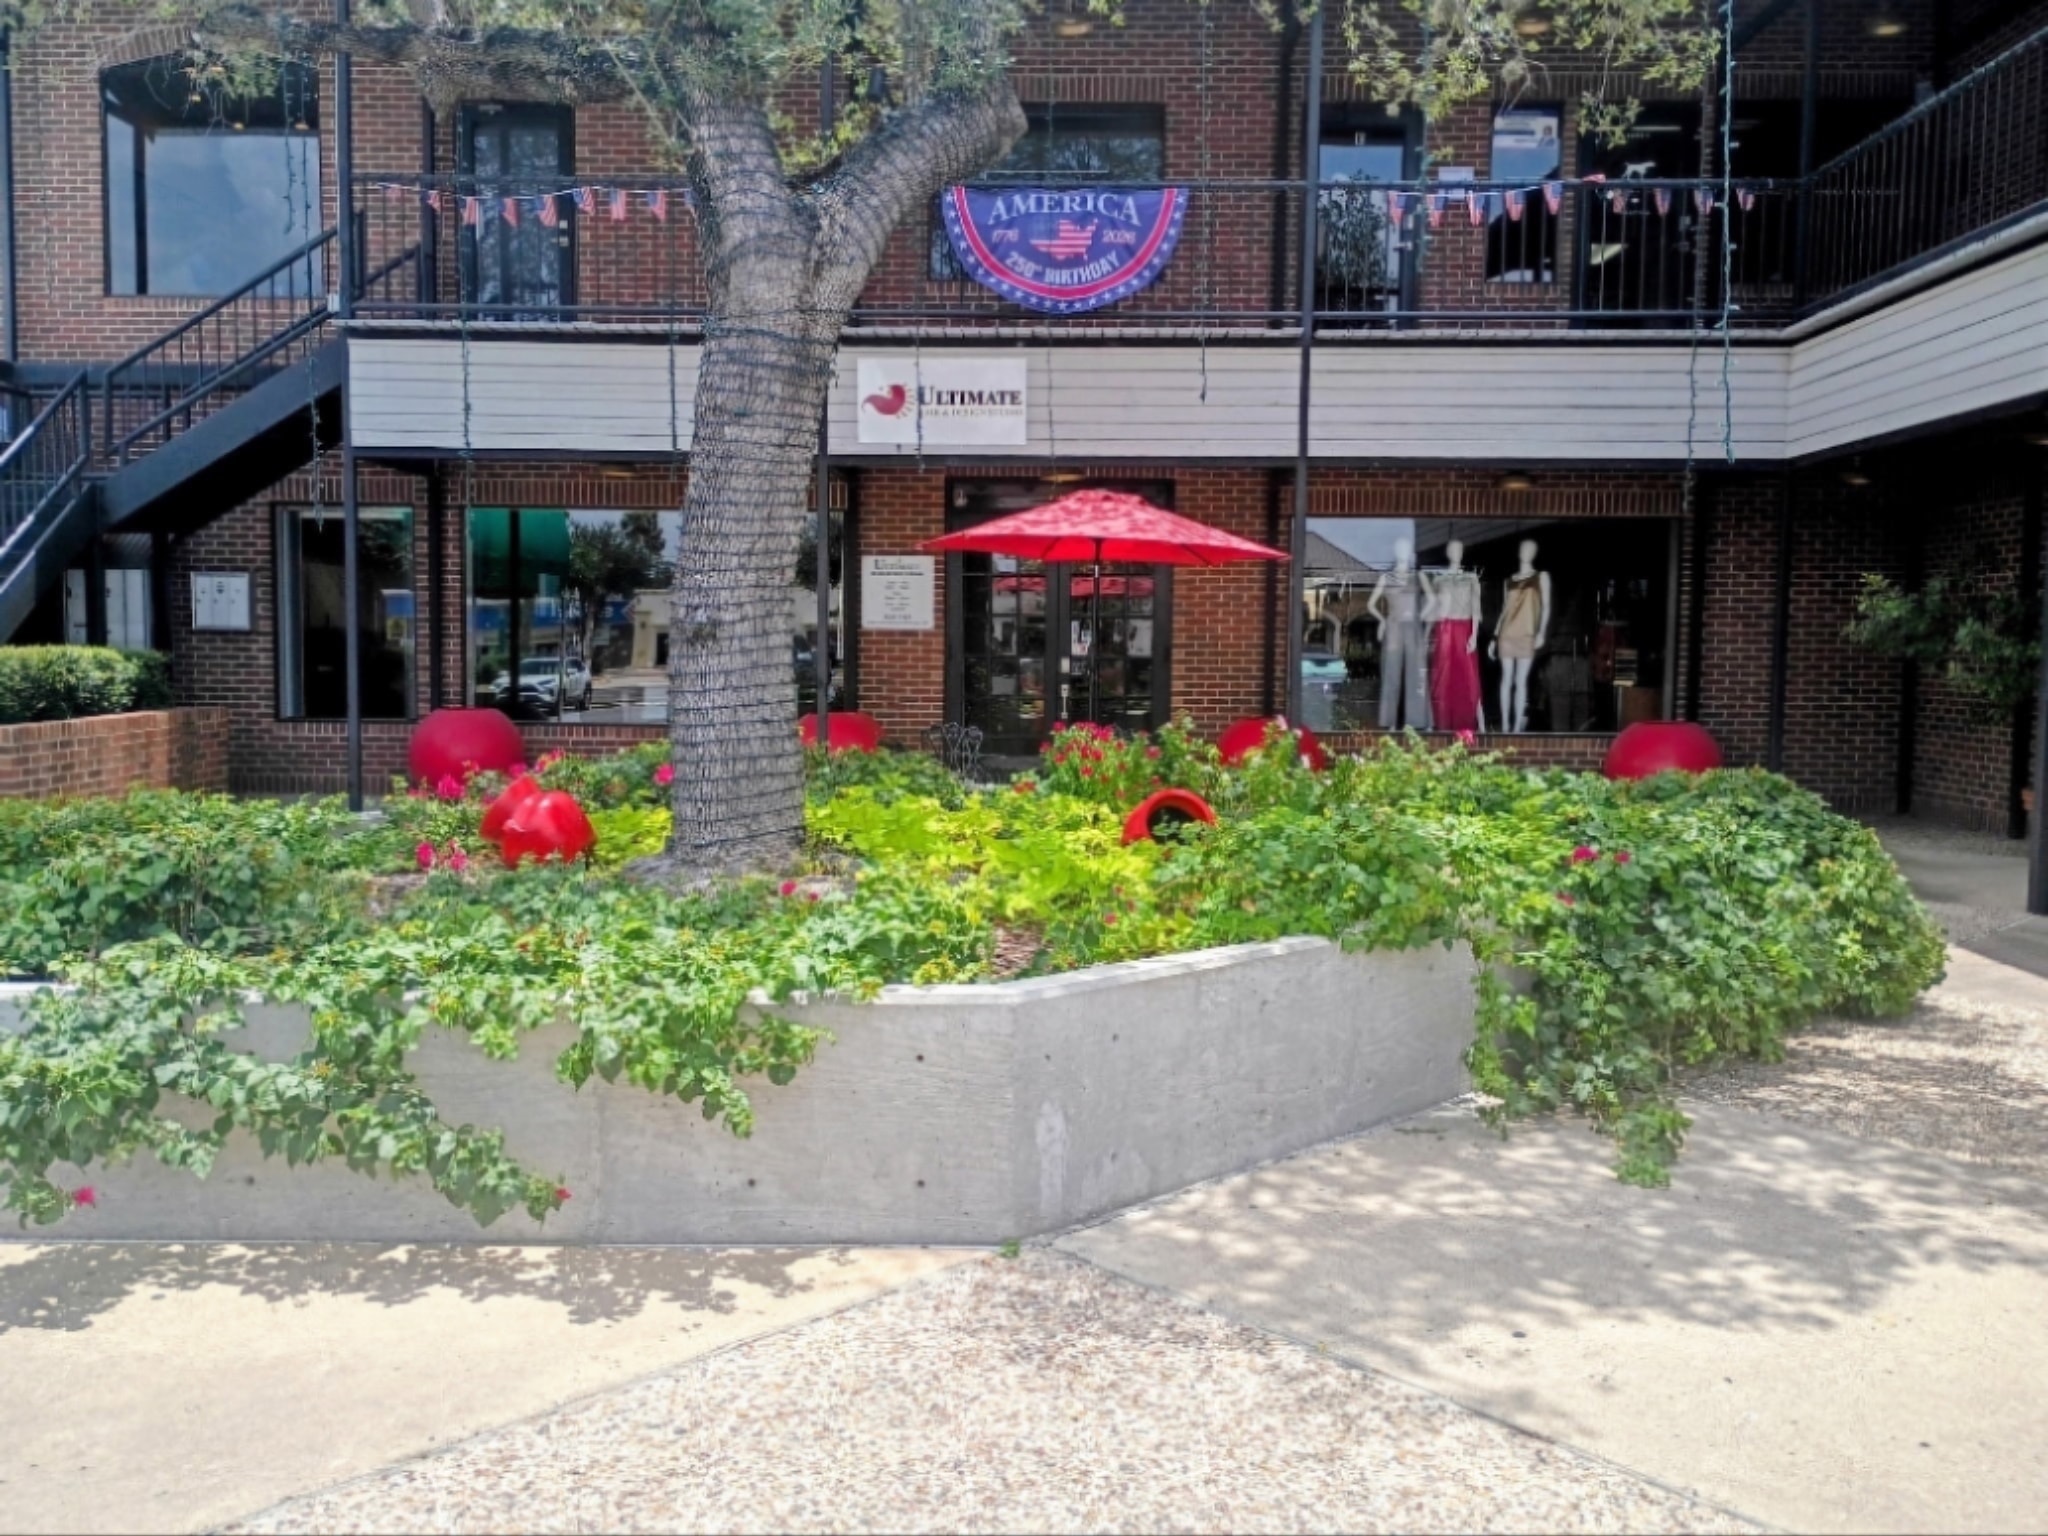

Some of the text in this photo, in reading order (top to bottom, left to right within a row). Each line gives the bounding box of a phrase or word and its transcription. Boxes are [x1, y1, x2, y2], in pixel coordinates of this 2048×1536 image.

[988, 193, 1141, 226] AMERICA
[1043, 249, 1120, 285] BIRTHDAY
[917, 386, 1022, 406] ULTIMATE
